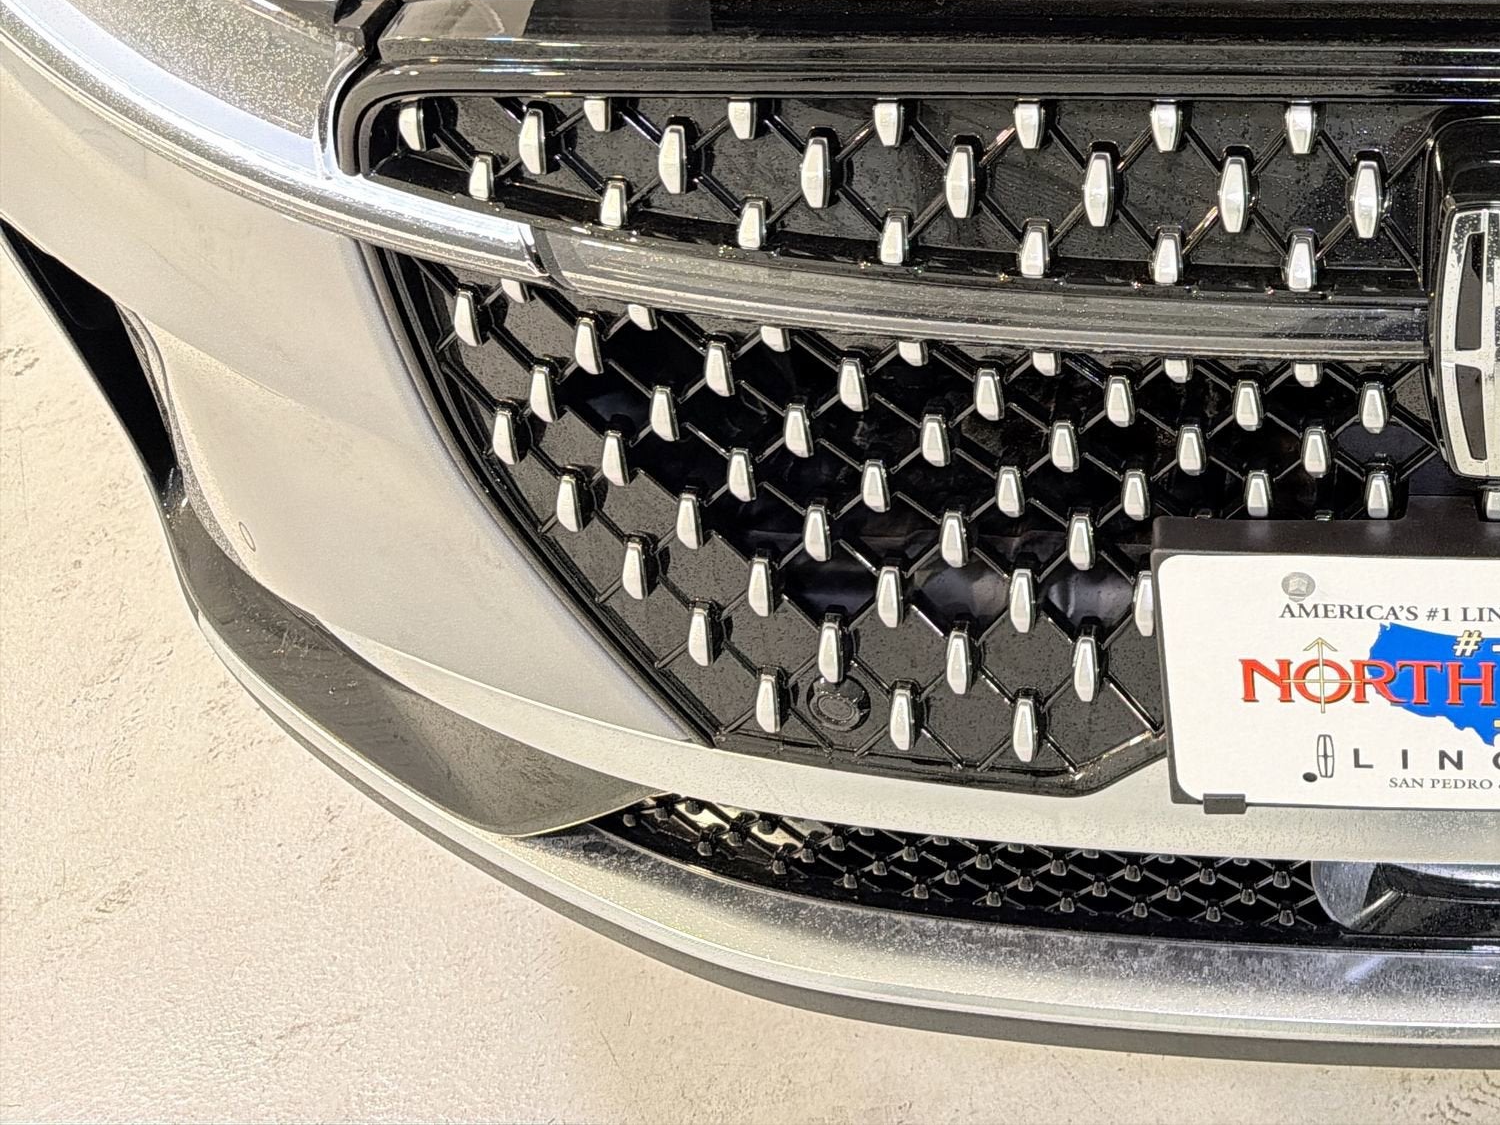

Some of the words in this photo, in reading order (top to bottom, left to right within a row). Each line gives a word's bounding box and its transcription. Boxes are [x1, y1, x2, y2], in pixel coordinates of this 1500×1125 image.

[1279, 602, 1420, 624] AMERICA'S
[1426, 606, 1452, 622] #1
[1239, 658, 1495, 708] NORTH
[1387, 777, 1426, 789] SAN
[1429, 778, 1494, 790] PEDRO
